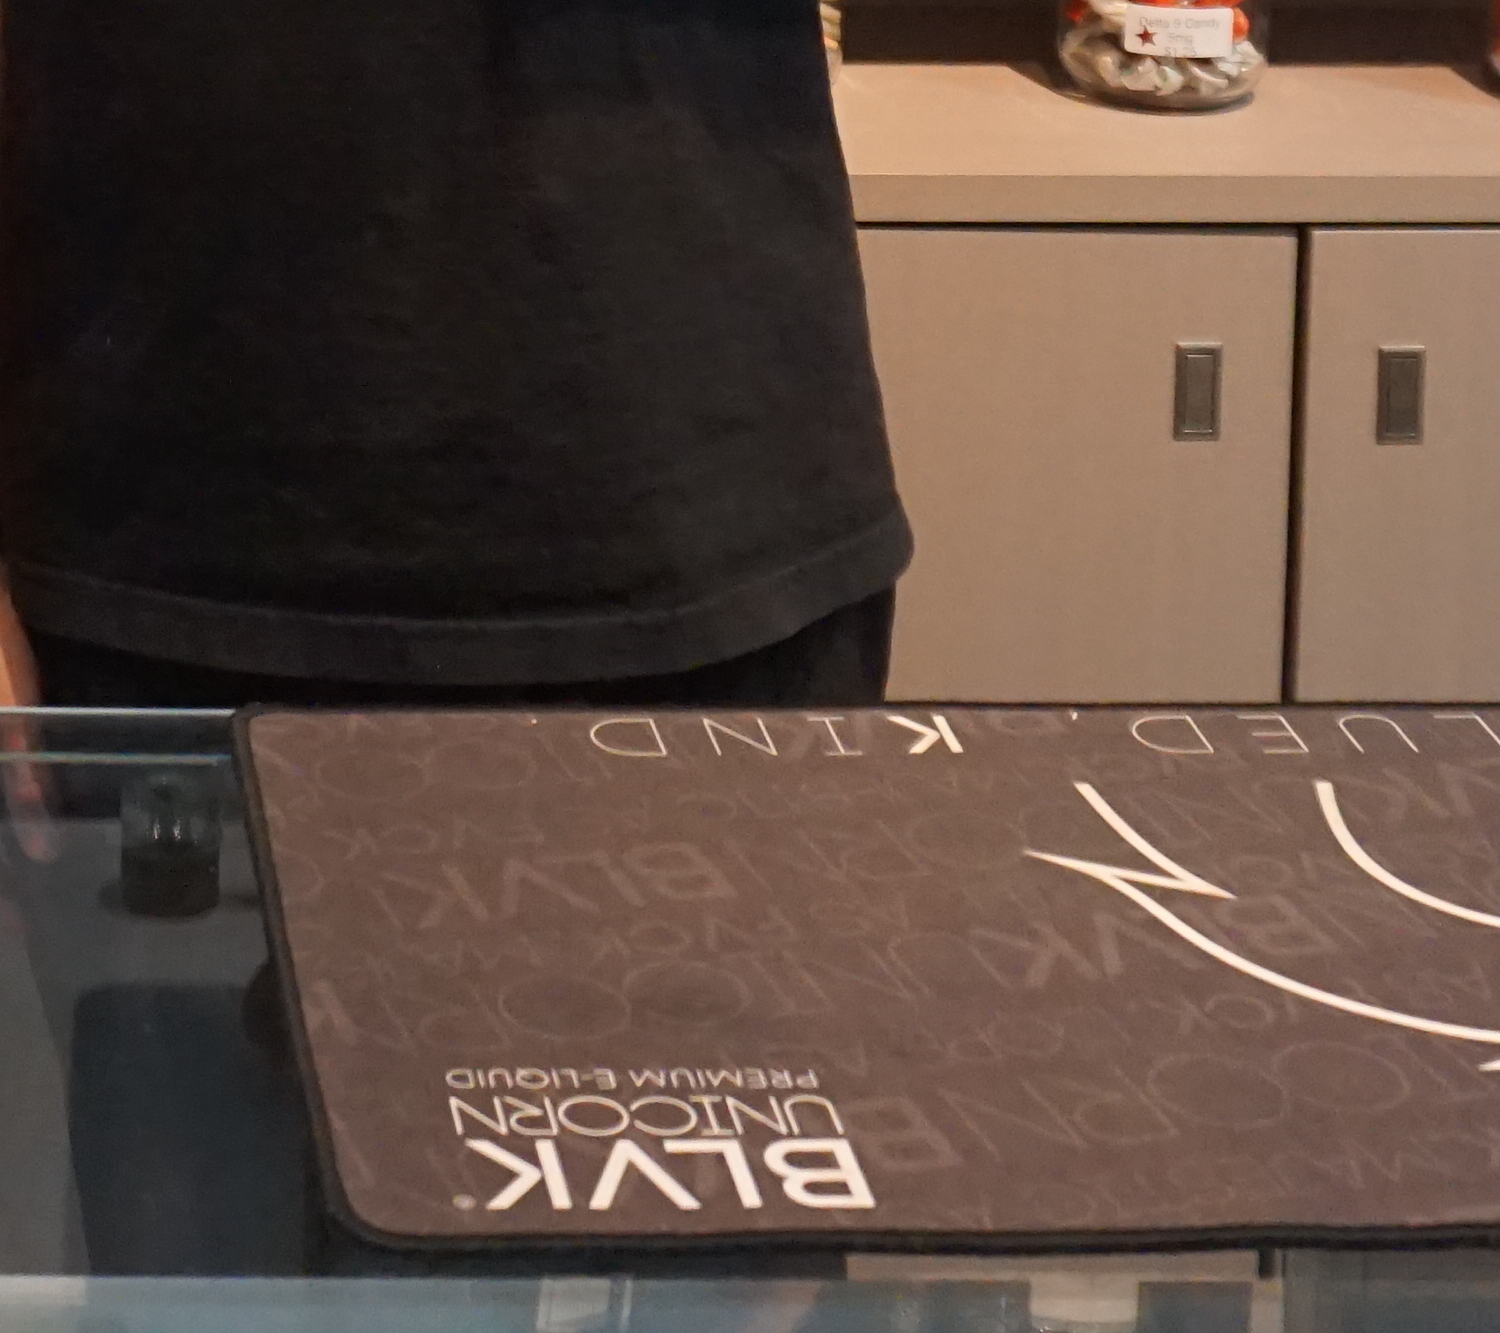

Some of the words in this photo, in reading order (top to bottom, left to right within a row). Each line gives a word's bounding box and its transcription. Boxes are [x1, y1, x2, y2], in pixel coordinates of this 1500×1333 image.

[1139, 16, 1170, 29] Delta
[1172, 18, 1181, 29] 9
[1184, 17, 1220, 30] Candy
[445, 1067, 618, 1090] E-LIQUID
[629, 1067, 820, 1090] PREMIUM
[448, 1094, 846, 1136] UNICORN
[464, 1137, 878, 1211] BLVK
